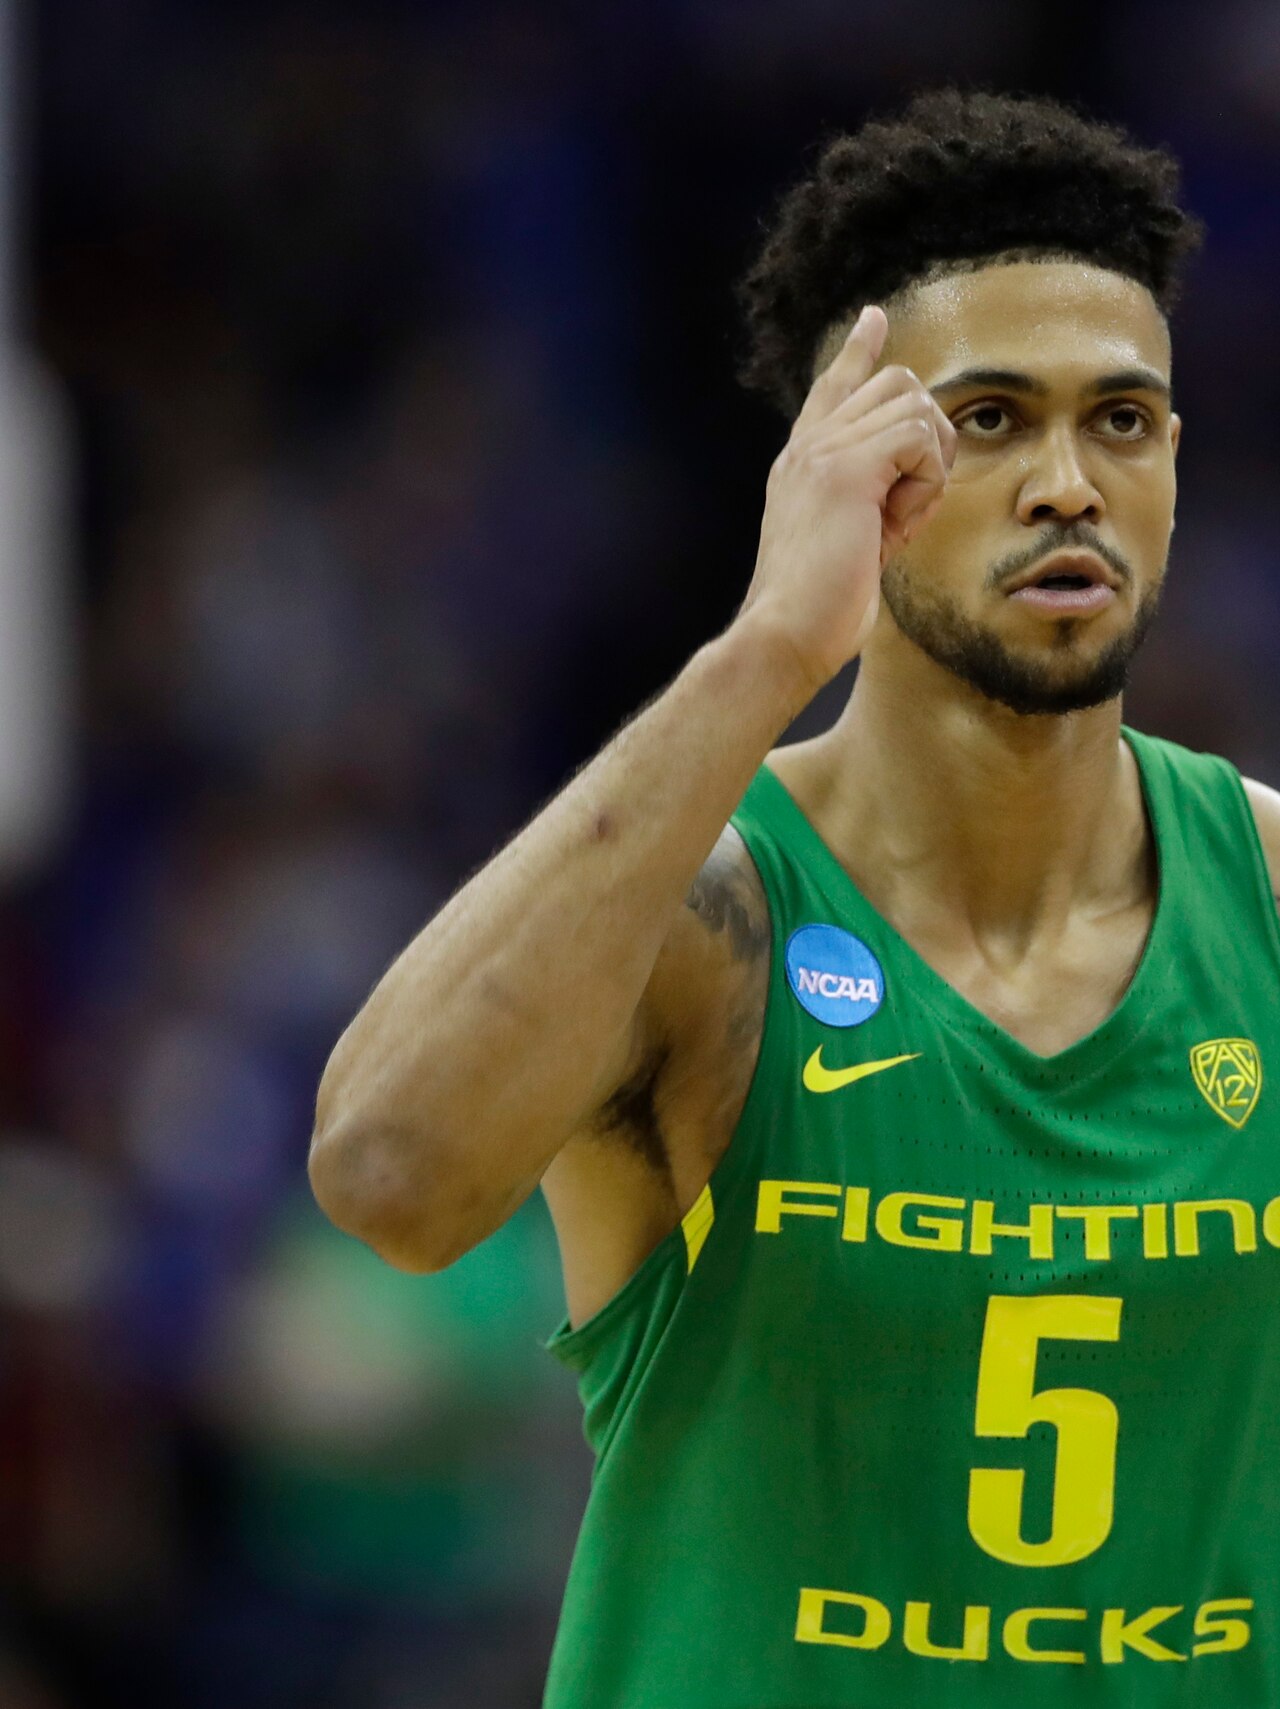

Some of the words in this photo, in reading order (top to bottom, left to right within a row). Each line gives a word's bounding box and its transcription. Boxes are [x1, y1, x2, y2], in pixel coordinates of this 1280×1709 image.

[797, 966, 879, 1003] NCAA
[1196, 1043, 1256, 1092] PAC
[1215, 1074, 1249, 1108] 12
[968, 1294, 1123, 1567] 5
[794, 1587, 1254, 1664] DUCKS
